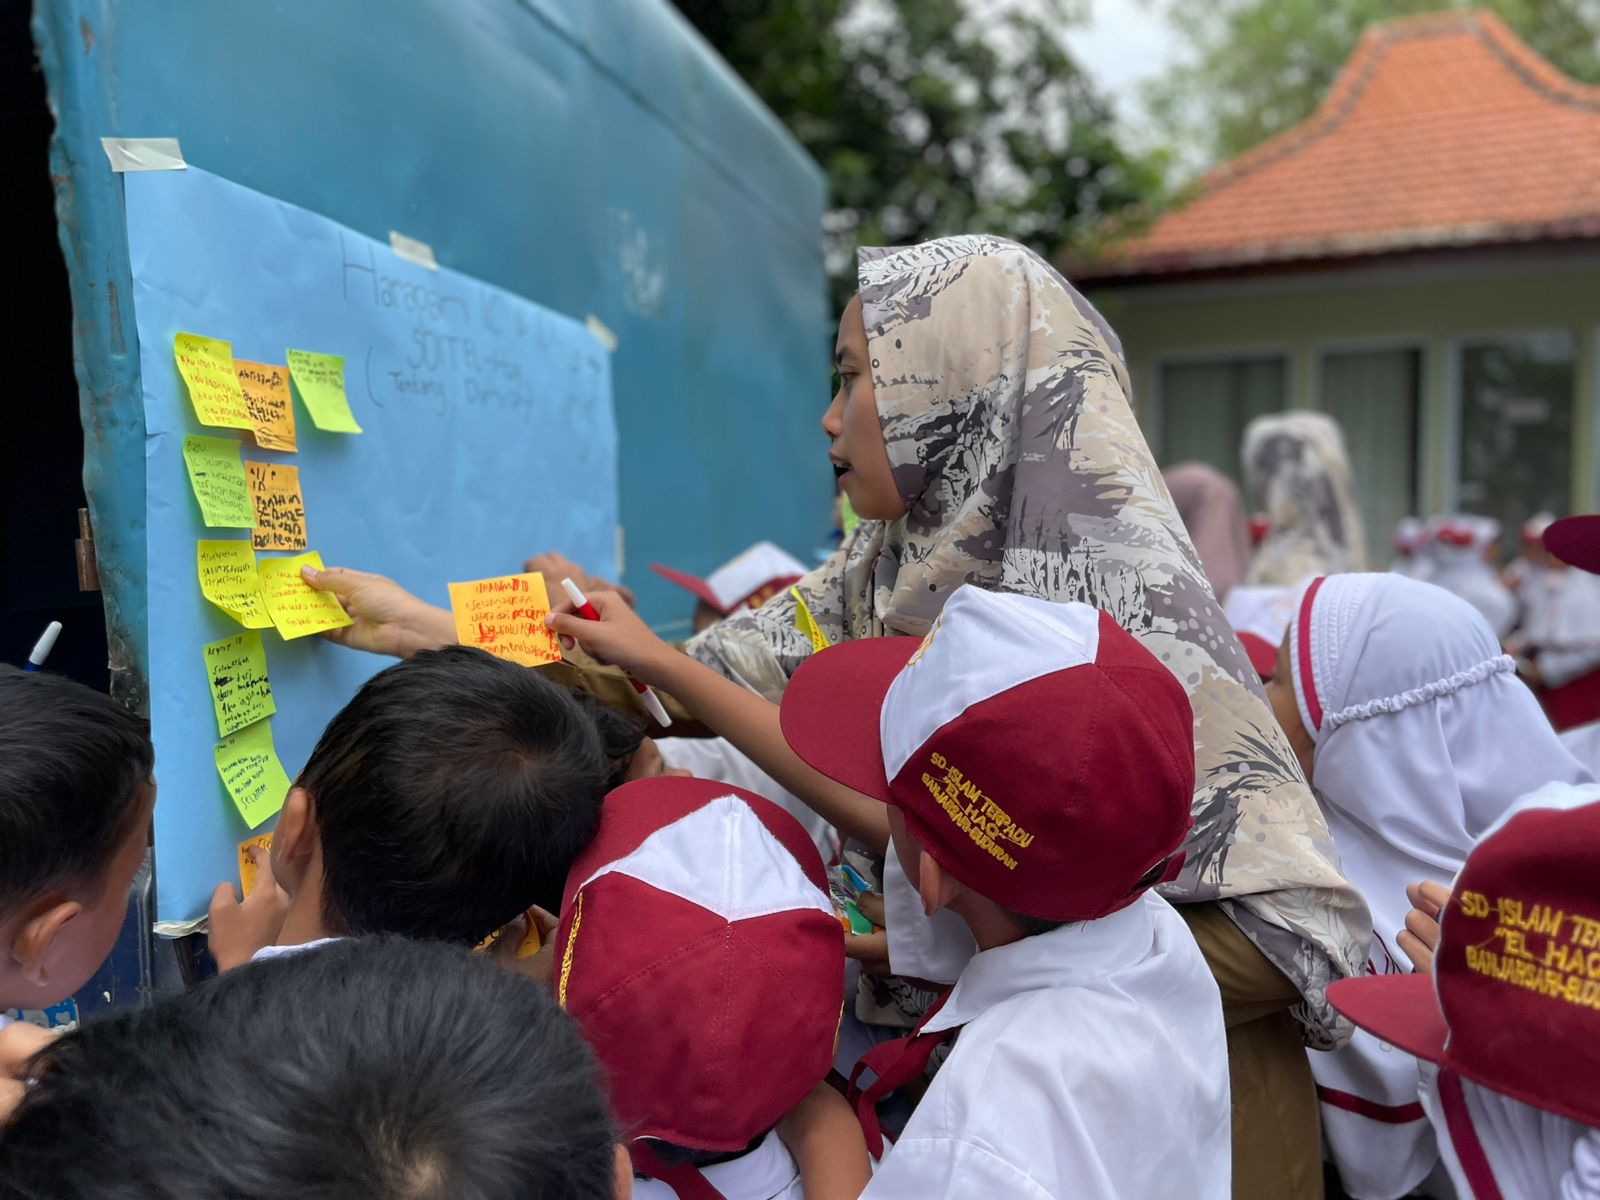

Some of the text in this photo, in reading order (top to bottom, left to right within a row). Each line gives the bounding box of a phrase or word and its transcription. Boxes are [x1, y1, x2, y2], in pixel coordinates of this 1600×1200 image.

[930, 752, 1035, 849] SD ISLAM TERPADU
[1460, 890, 1489, 918] SD
[1497, 897, 1564, 937] ISLAM
